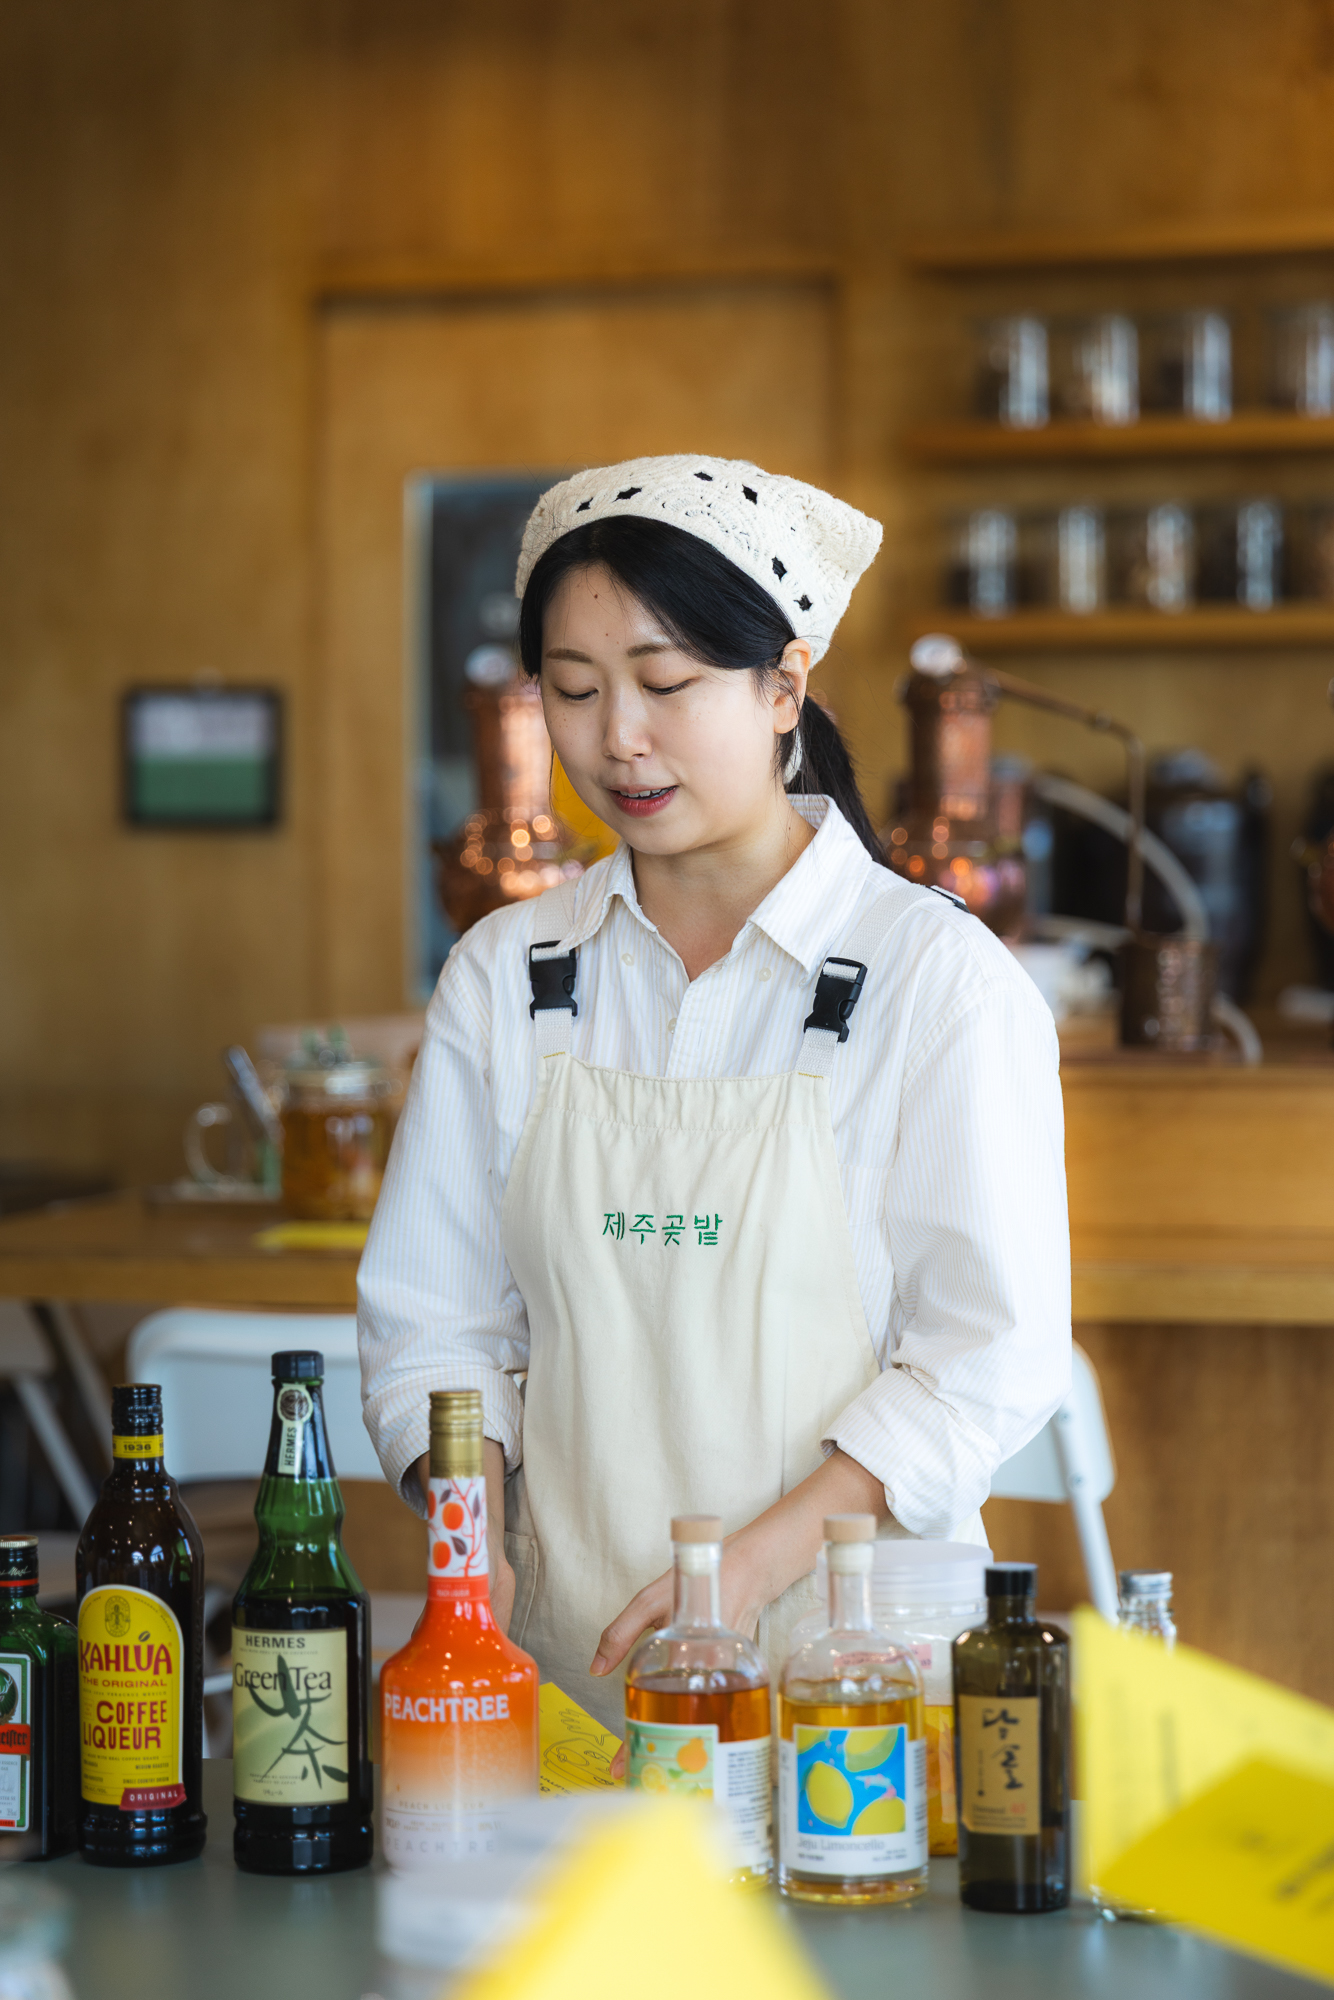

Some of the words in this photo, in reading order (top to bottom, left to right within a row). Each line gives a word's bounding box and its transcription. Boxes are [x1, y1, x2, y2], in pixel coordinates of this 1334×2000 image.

[602, 1211, 723, 1247] 제주곶밭
[123, 1443, 152, 1451] 1936
[284, 1426, 298, 1467] HERMES
[245, 1634, 306, 1649] HERMES
[82, 1675, 99, 1687] THE
[101, 1678, 168, 1689] ORIGINAL
[234, 1662, 288, 1691] Green
[289, 1666, 332, 1691] Tea
[96, 1699, 168, 1725] COFFEE
[384, 1692, 510, 1723] PEACHTREE
[0, 1729, 28, 1749] eister
[83, 1721, 162, 1750] LIQUEUR
[129, 1790, 178, 1802] ORIGINAL
[386, 1836, 495, 1854] PEACHTRE
[820, 1838, 885, 1851] Limoncello
